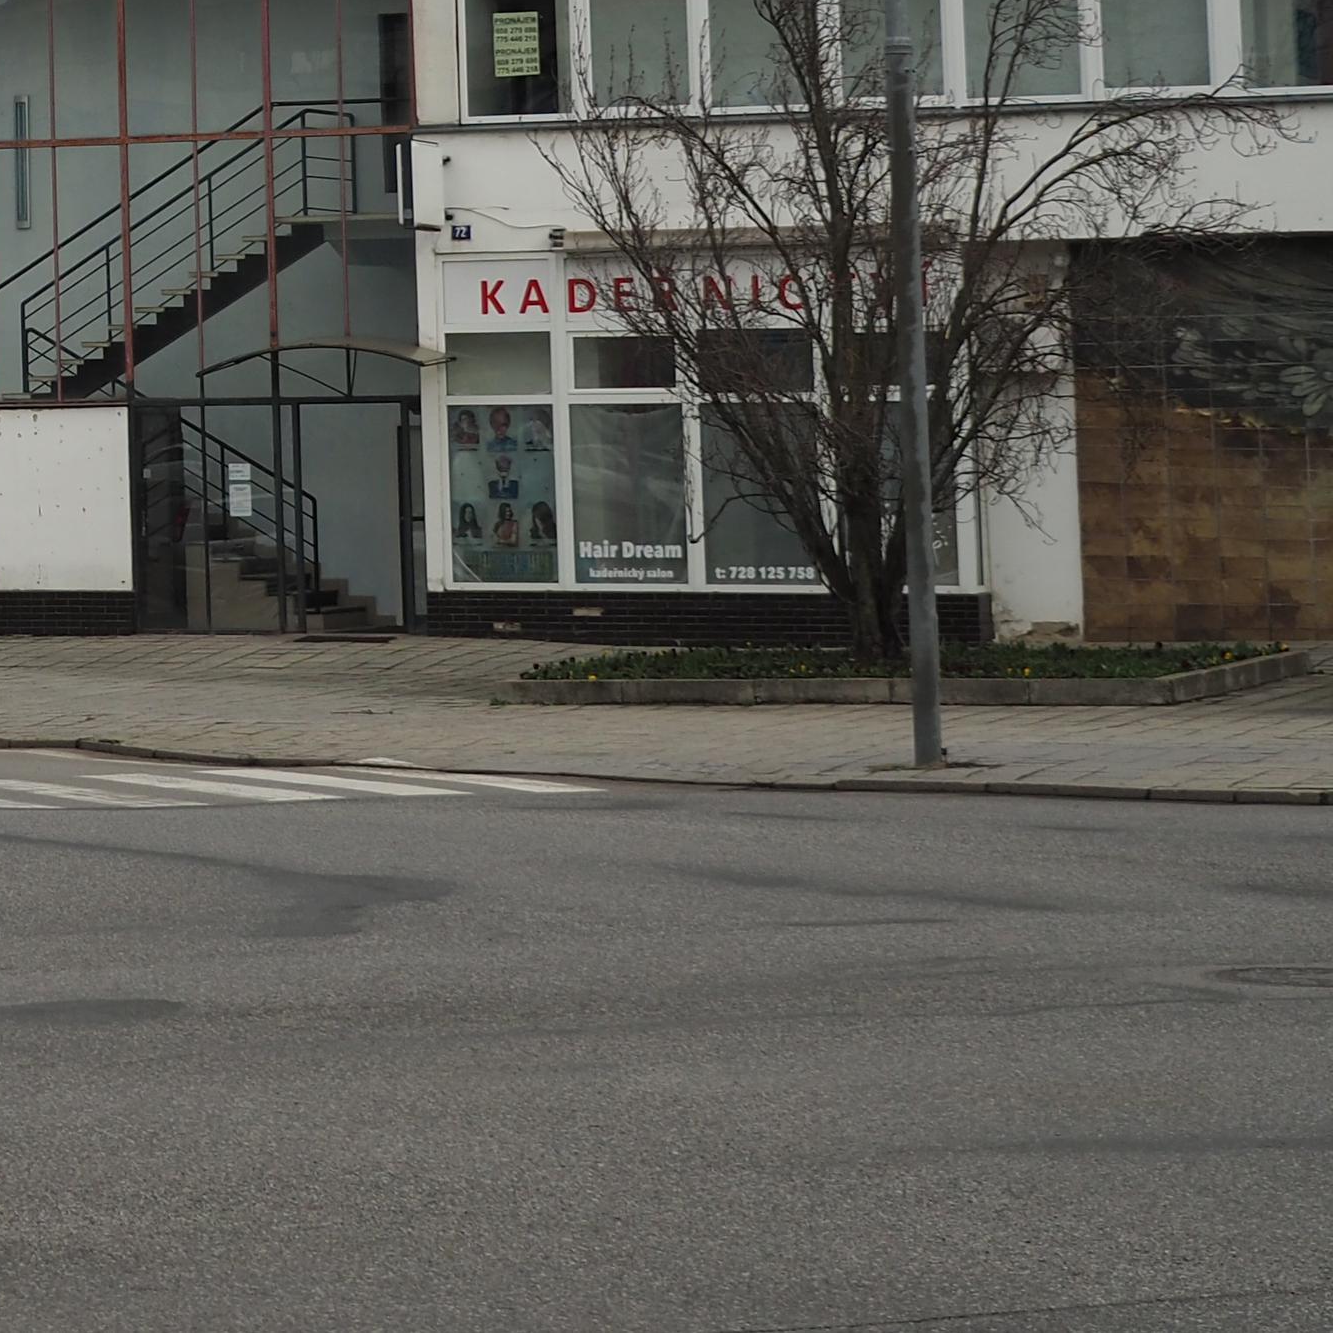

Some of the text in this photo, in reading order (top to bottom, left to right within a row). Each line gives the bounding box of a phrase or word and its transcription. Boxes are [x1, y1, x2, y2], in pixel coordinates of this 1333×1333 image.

[454, 226, 468, 238] 72
[480, 257, 932, 315] KADEŘNICÍ
[579, 540, 683, 558] Hair Dream
[589, 567, 674, 580] kadeřnický salon
[729, 566, 756, 579] 728
[759, 566, 785, 579] 125
[787, 566, 815, 579] 758
